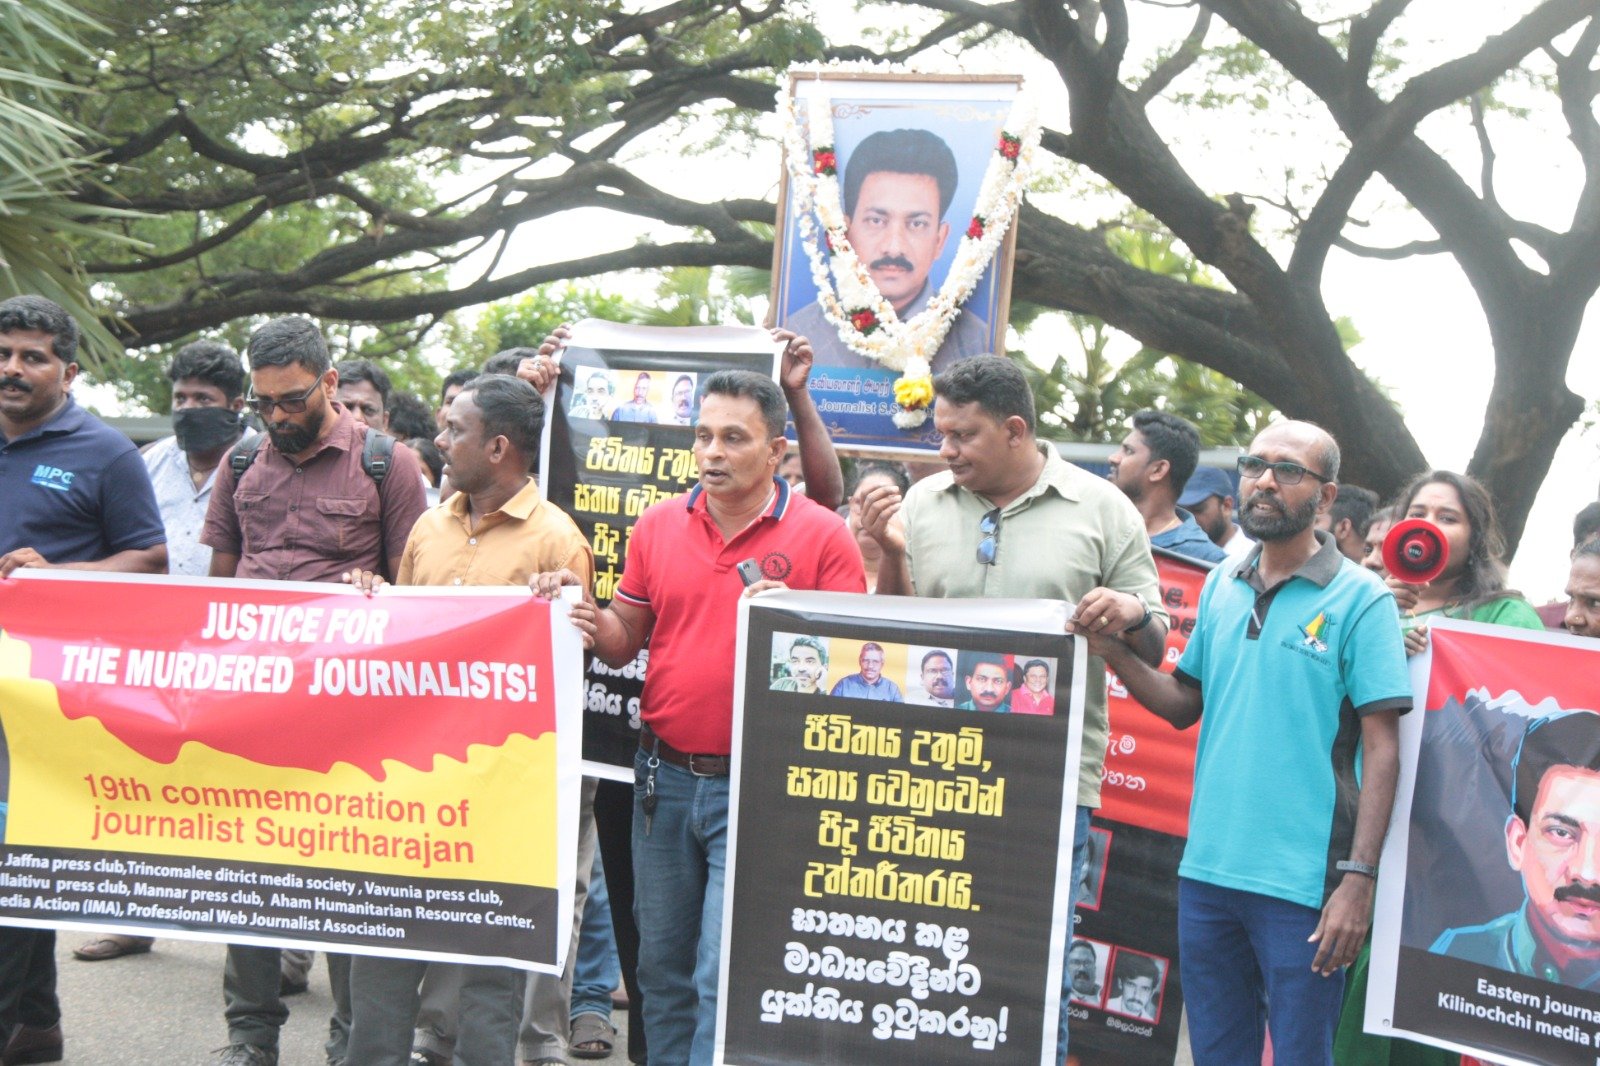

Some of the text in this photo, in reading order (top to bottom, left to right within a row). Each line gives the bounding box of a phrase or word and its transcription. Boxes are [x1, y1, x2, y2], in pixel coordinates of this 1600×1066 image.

[818, 399, 877, 415] Journalist
[33, 464, 75, 485] MPC
[586, 437, 654, 475] ජීවිතය
[202, 602, 389, 644] JUSTICE FOR
[62, 645, 121, 685] THE
[124, 649, 294, 694] MURDERED
[308, 657, 537, 702] JOURNALISTS!
[804, 714, 992, 772] ජීවිතය උතුම්,
[84, 774, 470, 827] 19th commemoration of
[866, 769, 1005, 817] වෙනුවෙන්
[91, 804, 474, 869] journalist Sugirtharajan
[867, 815, 965, 861] ජීවිතය
[4, 852, 49, 868] Jaffna
[52, 858, 91, 871] press
[215, 868, 257, 885] ditrict
[260, 873, 303, 888] media
[306, 877, 355, 895] society
[364, 881, 422, 899] Vavunia
[426, 888, 465, 902] press
[468, 889, 503, 906] club,
[33, 895, 80, 912] Action
[83, 899, 124, 917] (IMA),
[127, 902, 213, 923] Professional
[216, 909, 247, 926] Web
[250, 912, 320, 931] Journalist
[323, 918, 405, 938] Association
[56, 878, 95, 893] press
[97, 879, 131, 896] club,
[133, 882, 188, 899] Mannar
[191, 888, 228, 904] press
[231, 890, 264, 907] club,
[271, 894, 311, 909] Aham
[315, 897, 412, 919] Humanitarian
[415, 906, 482, 924] Resource
[485, 911, 535, 930] Center.
[915, 922, 969, 961] කළ
[760, 982, 1009, 1050] යුක්තිය ඉටුකරනු!
[1477, 978, 1540, 1008] Eastern
[1438, 992, 1531, 1030] Kilinochchi
[1535, 1020, 1590, 1046] media
